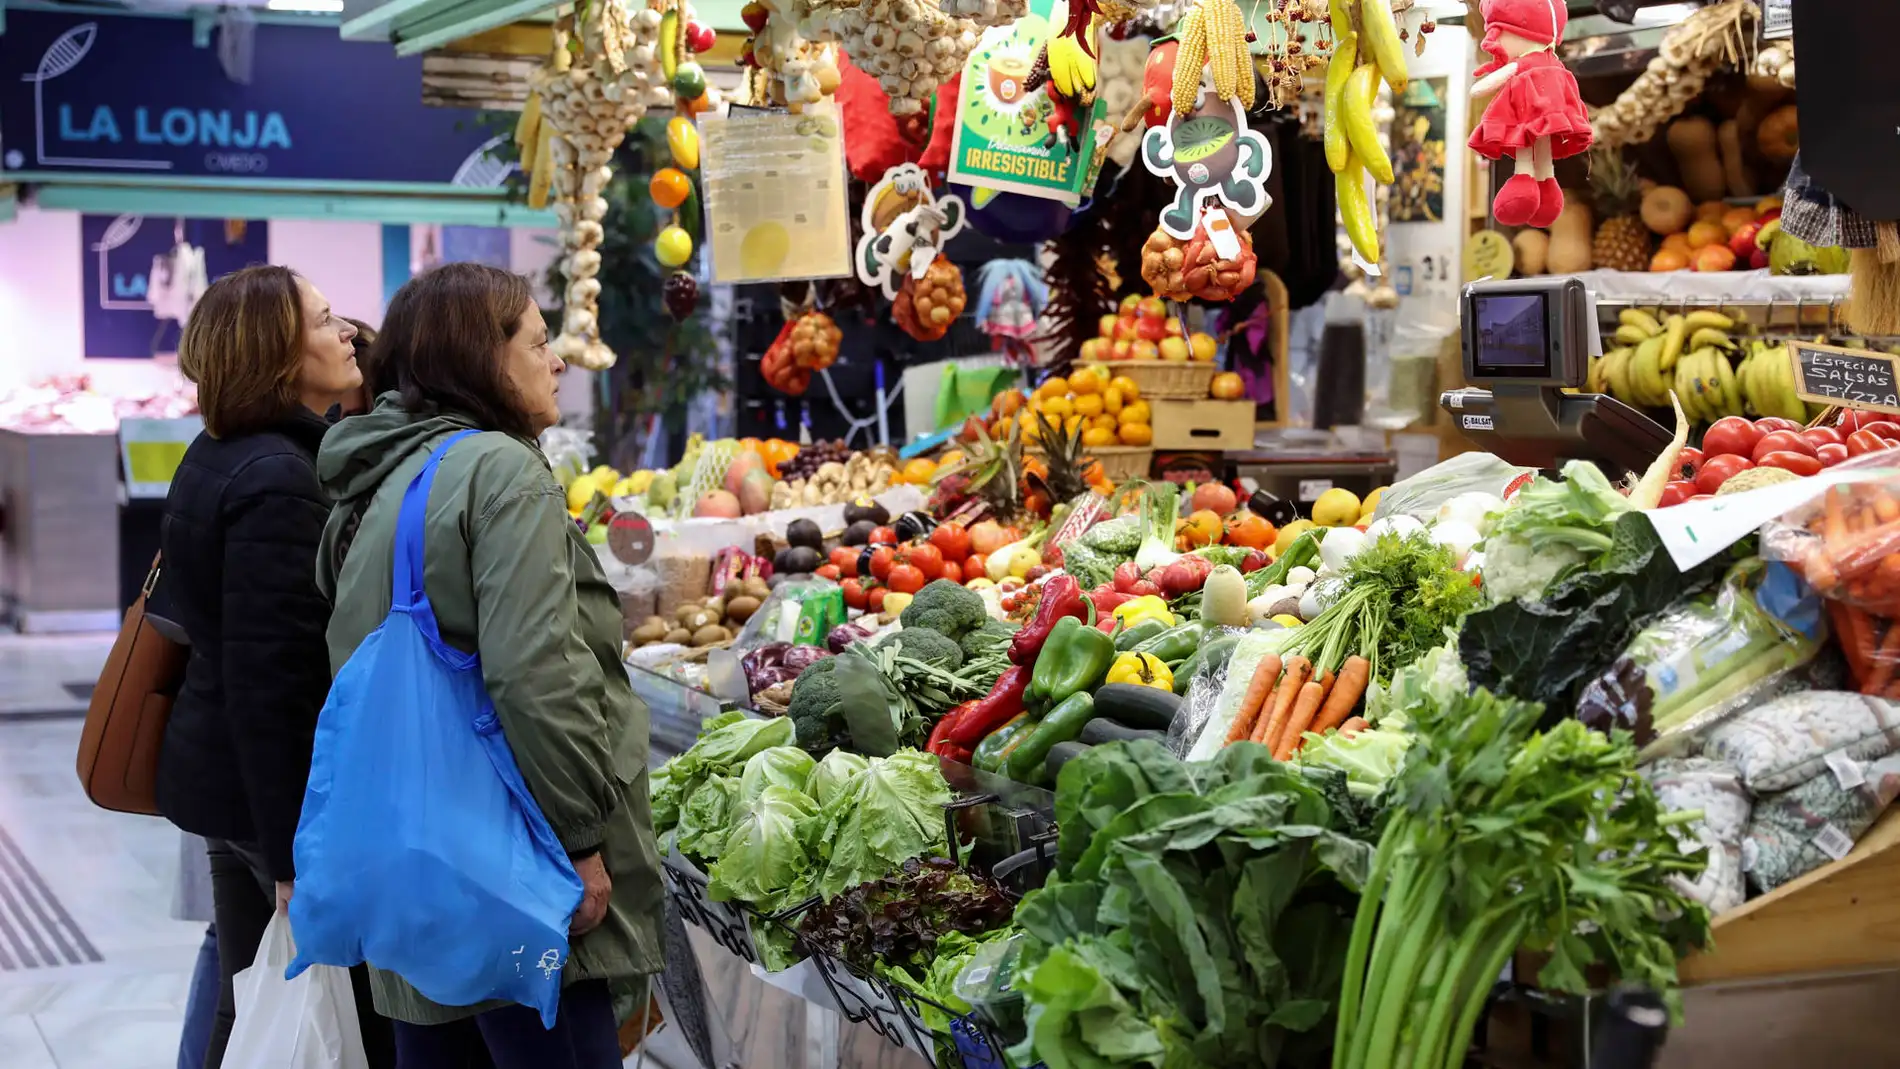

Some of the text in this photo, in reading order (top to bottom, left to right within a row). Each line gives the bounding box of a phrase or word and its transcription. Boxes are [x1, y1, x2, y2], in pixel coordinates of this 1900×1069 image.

[59, 103, 292, 149] LA LONJA
[966, 147, 1068, 182] IRRESISTIBLE
[1806, 367, 1888, 386] SALSAS
[1844, 381, 1853, 393] Y
